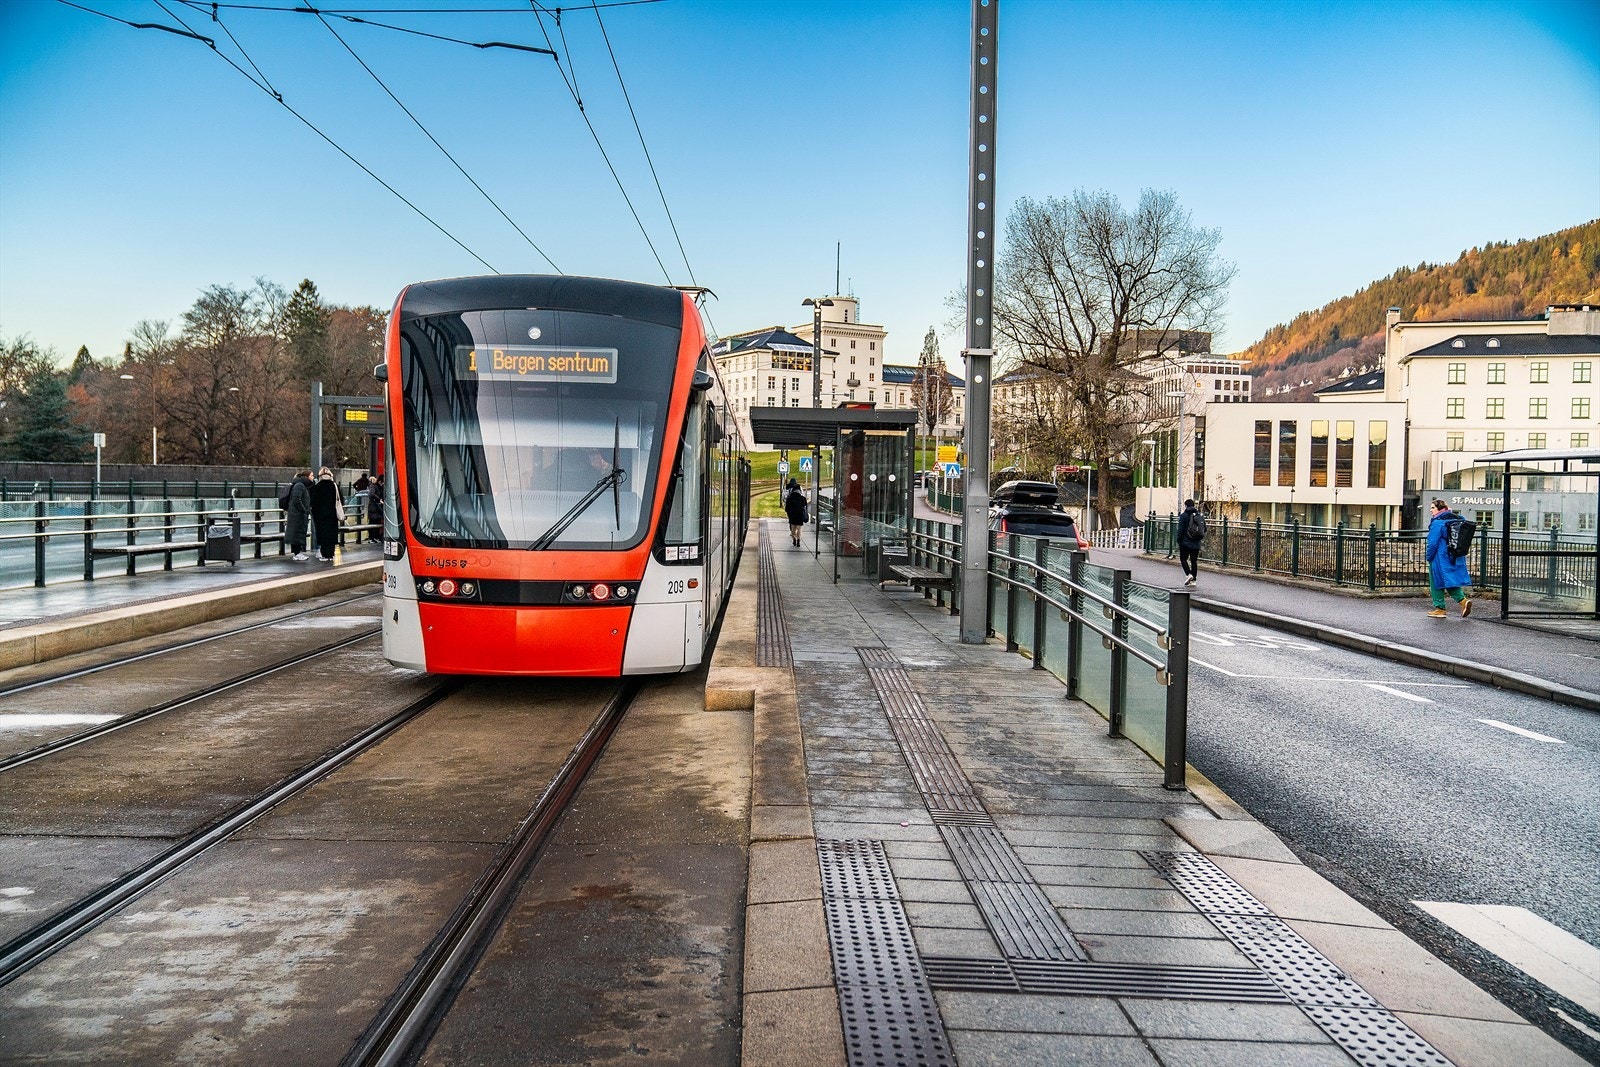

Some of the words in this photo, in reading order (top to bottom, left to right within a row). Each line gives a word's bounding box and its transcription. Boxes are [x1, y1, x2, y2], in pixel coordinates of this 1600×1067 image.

[468, 351, 477, 371] 1
[493, 350, 545, 375] Bergen
[547, 352, 609, 373] sentrum
[1452, 496, 1462, 504] ST.
[1464, 497, 1485, 505] PAUL
[1485, 497, 1520, 505] GYMAS
[425, 555, 458, 569] skyss
[388, 574, 397, 589] 209
[667, 580, 684, 595] 209
